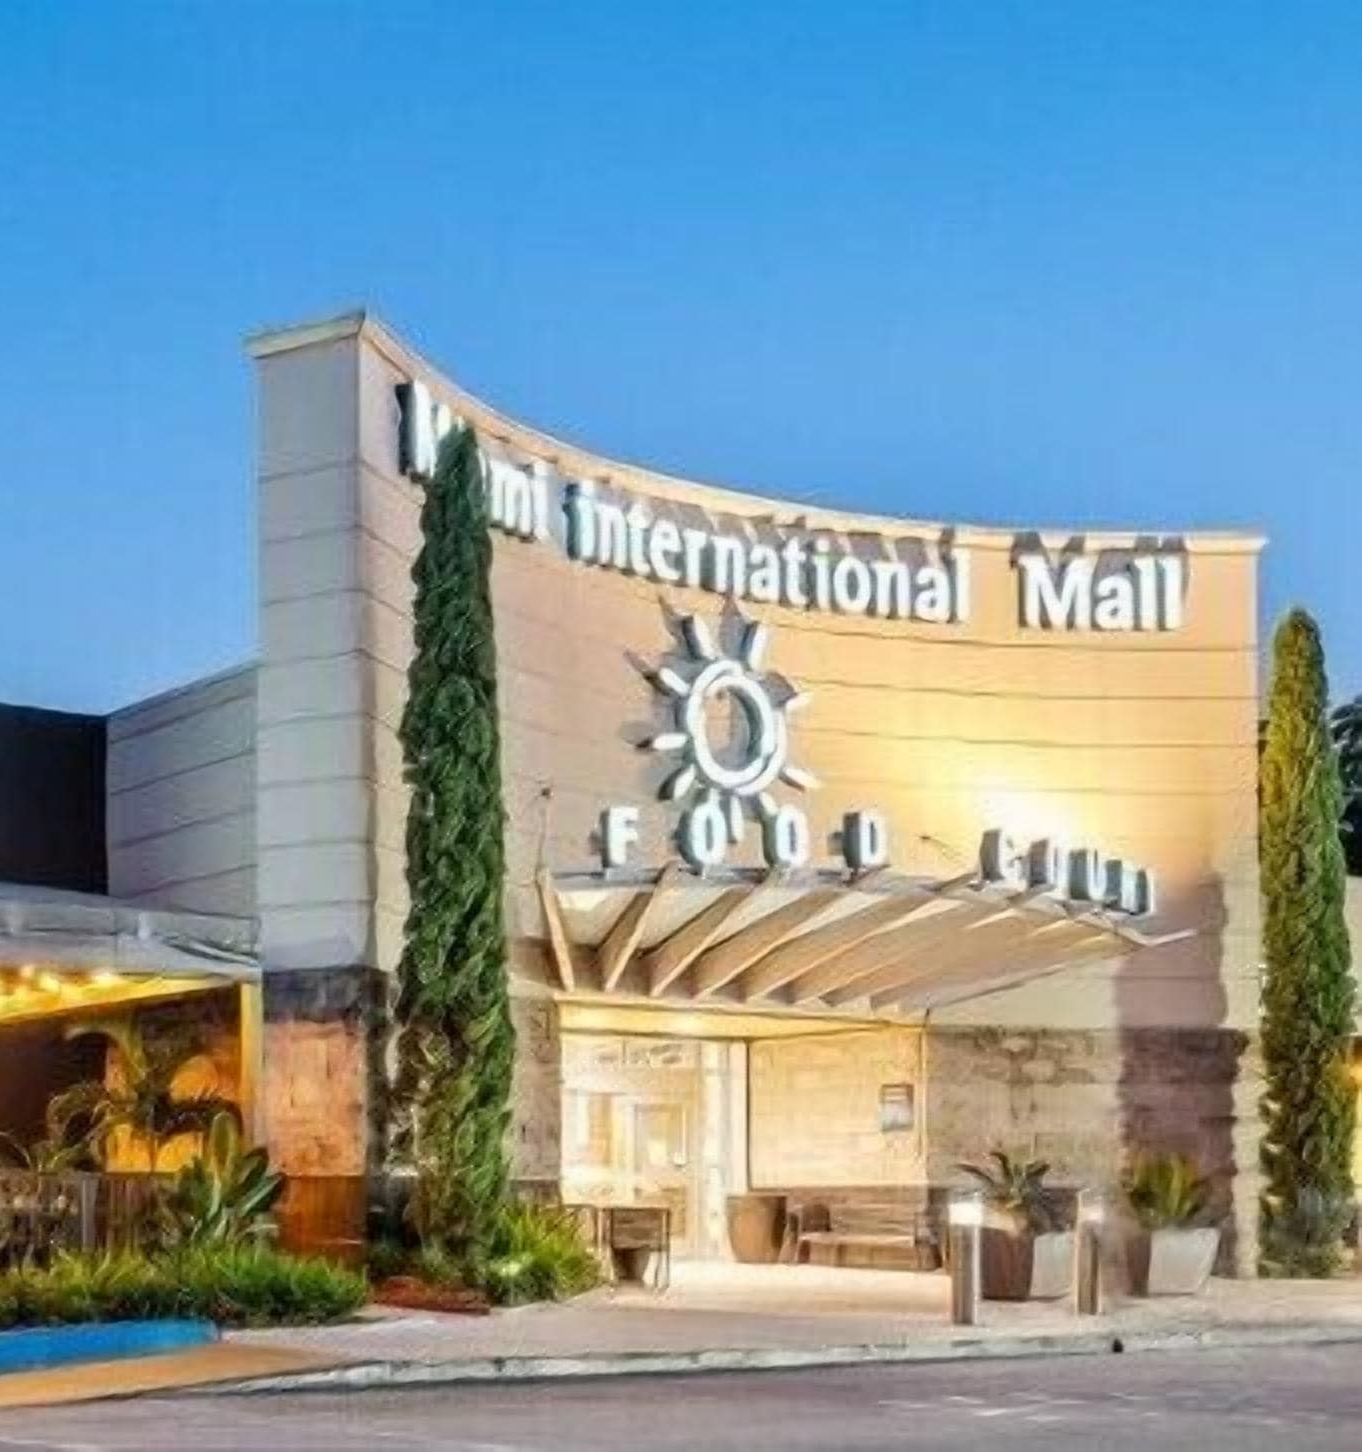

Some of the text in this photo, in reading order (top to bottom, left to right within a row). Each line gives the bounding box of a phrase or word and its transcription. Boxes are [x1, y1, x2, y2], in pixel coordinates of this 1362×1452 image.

[402, 380, 1183, 632] Mmi international Mall
